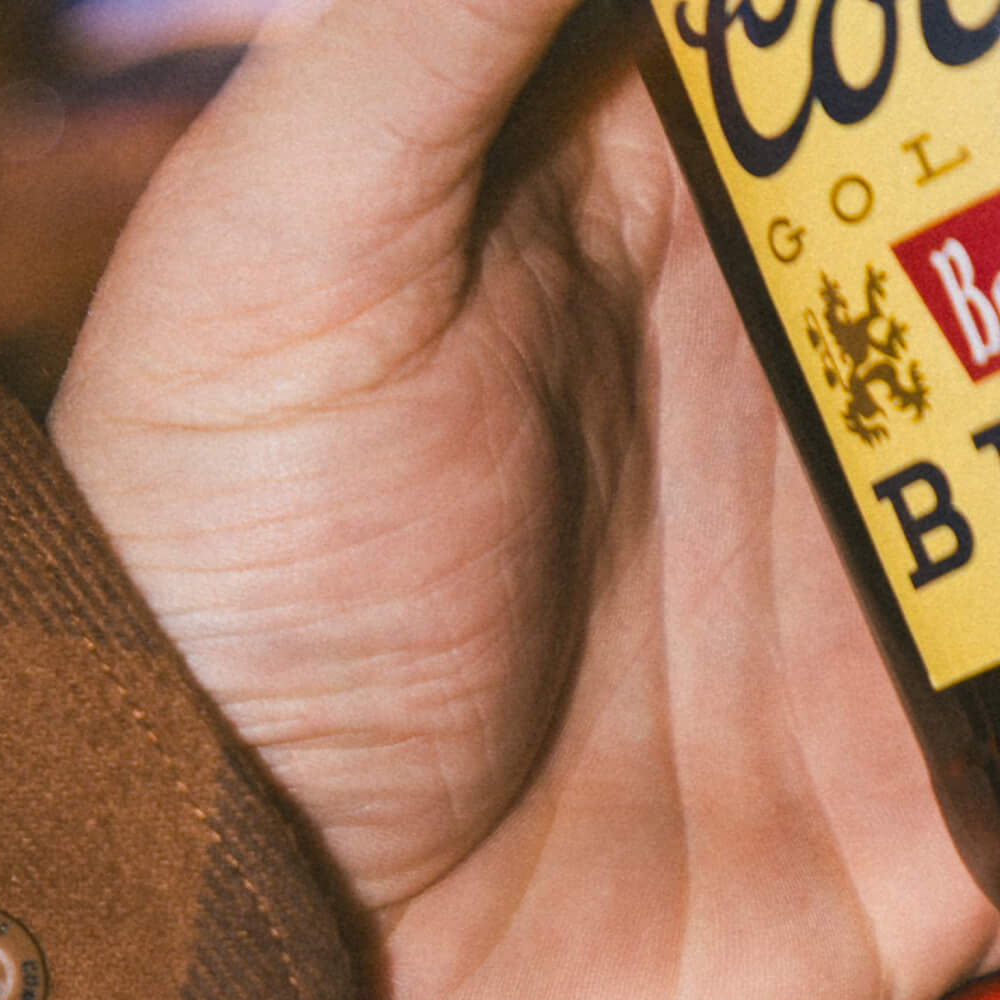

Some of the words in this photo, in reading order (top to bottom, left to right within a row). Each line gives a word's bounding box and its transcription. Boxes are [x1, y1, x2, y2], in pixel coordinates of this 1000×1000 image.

[767, 131, 972, 264] GOL
[929, 237, 1000, 366] B
[871, 421, 1000, 591] B
